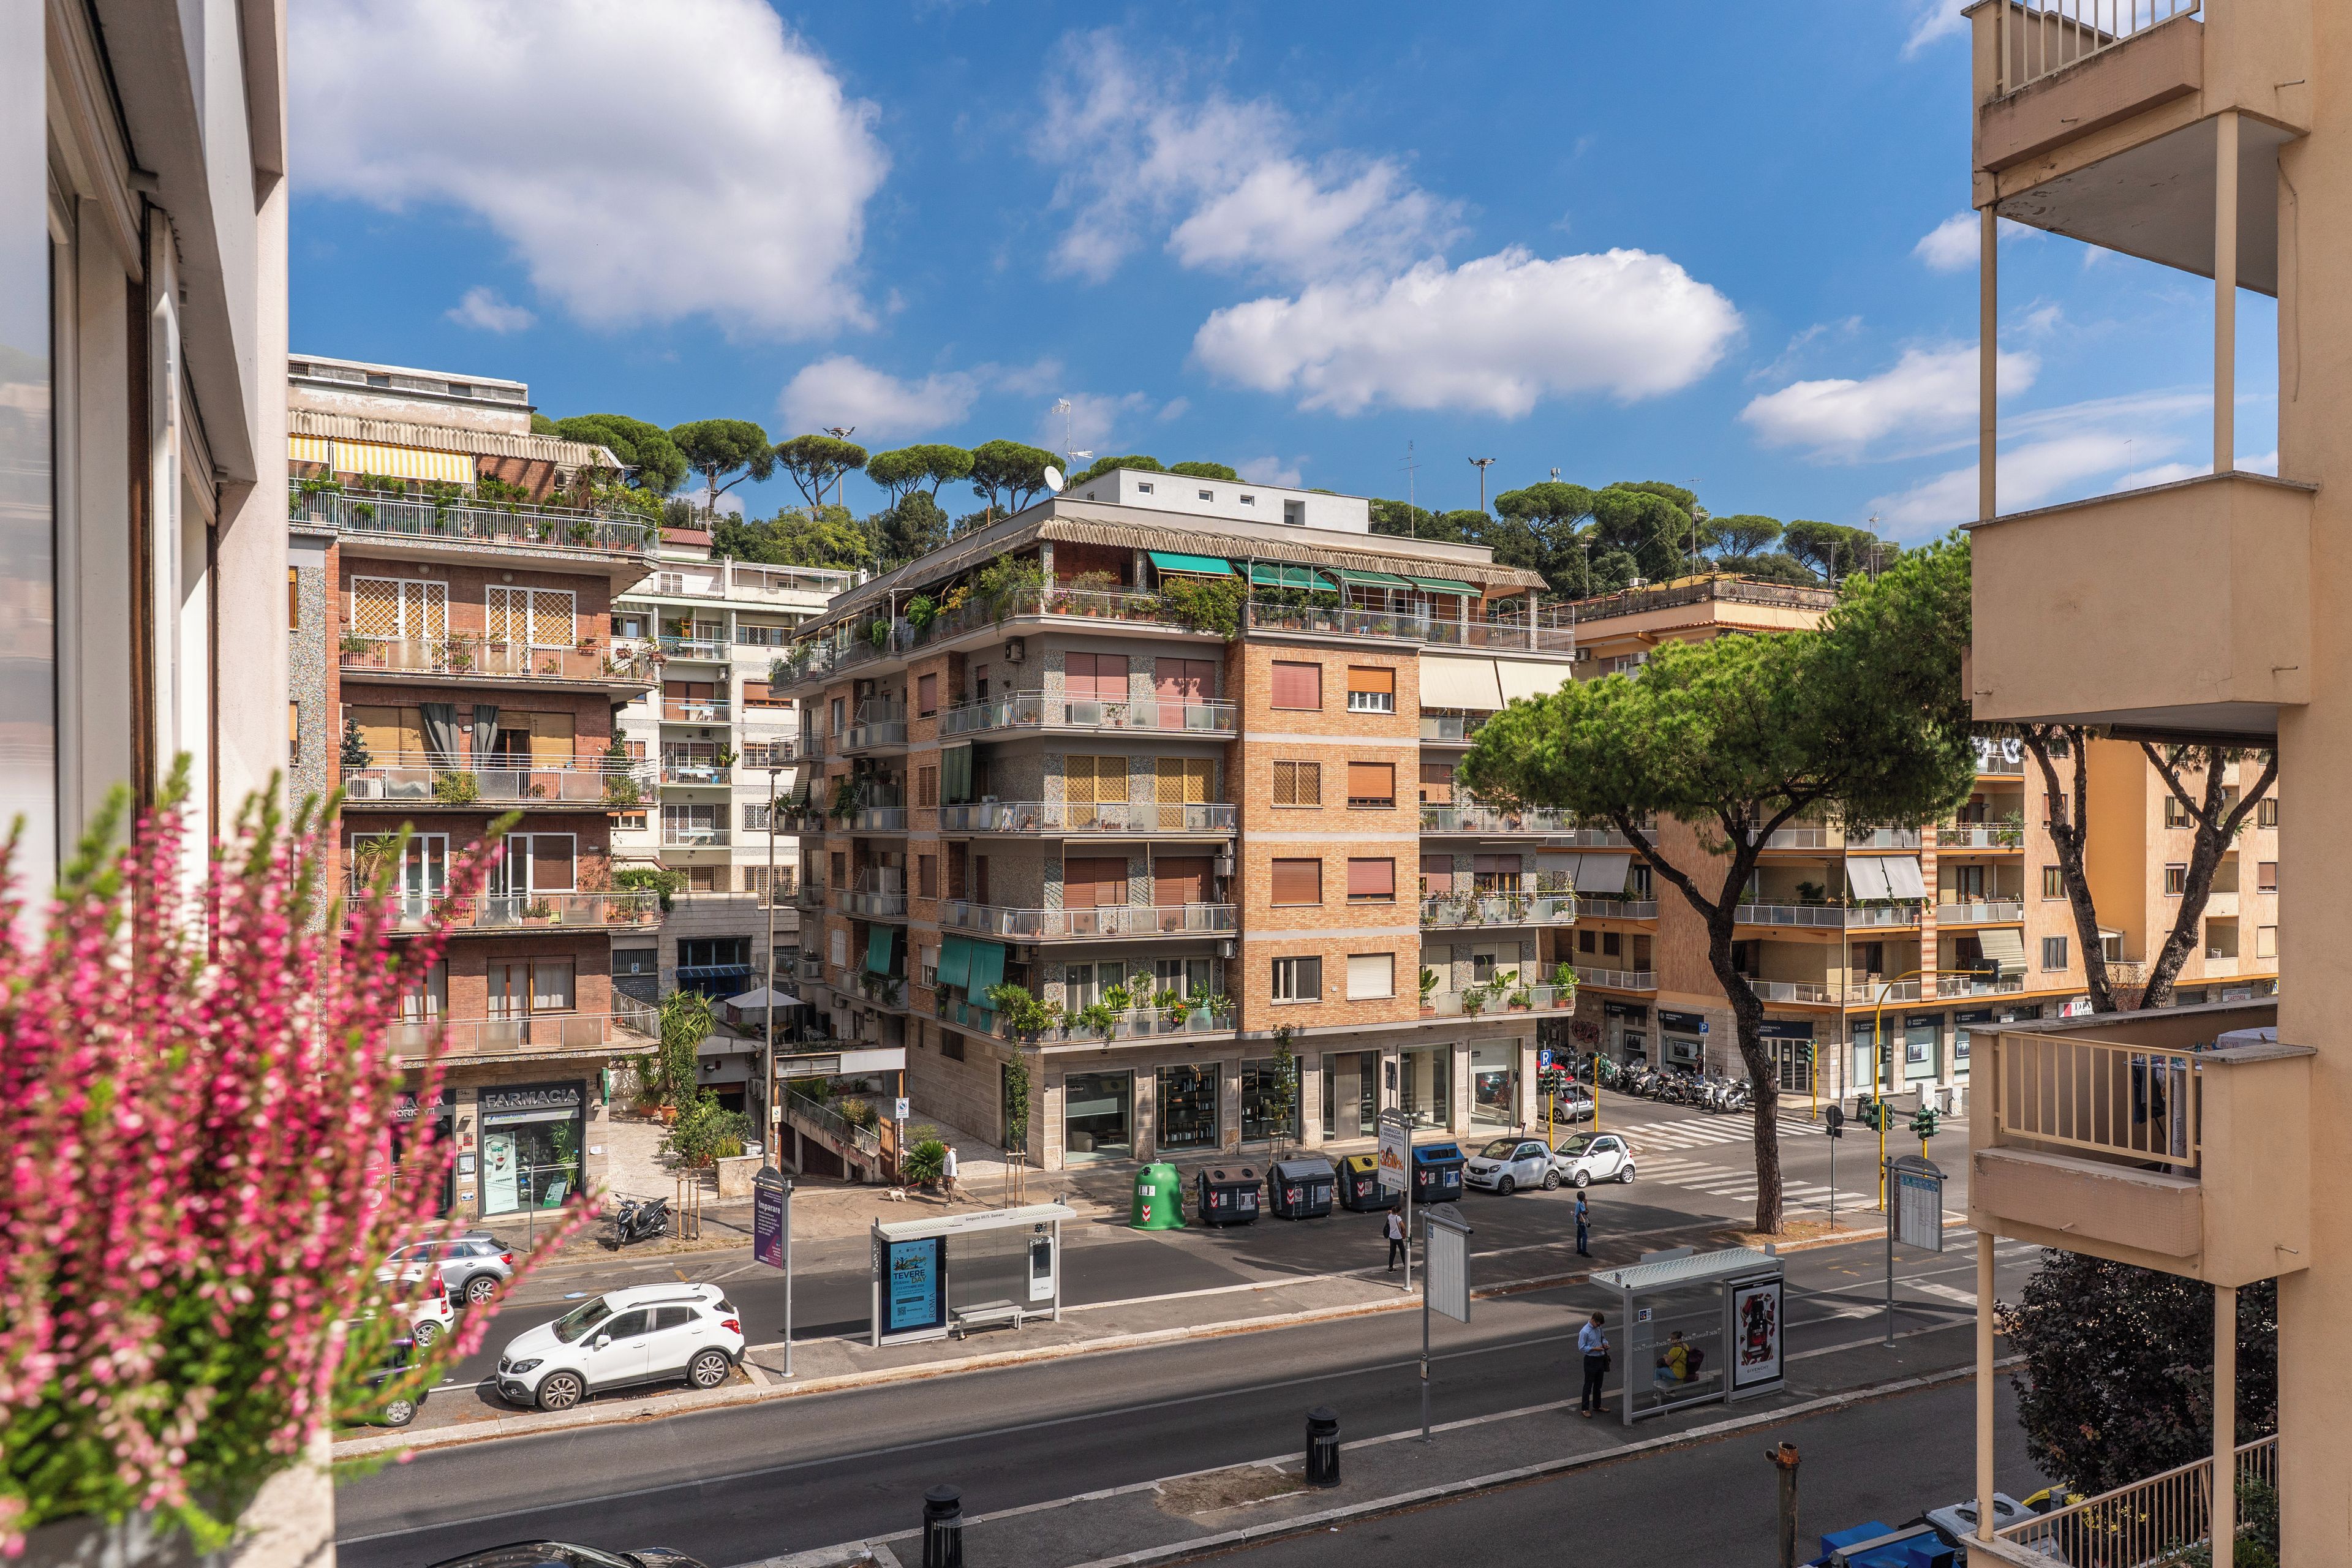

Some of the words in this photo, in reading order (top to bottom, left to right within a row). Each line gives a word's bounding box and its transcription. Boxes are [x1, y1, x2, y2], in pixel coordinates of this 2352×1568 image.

[485, 1088, 580, 1109] FARMACIA
[1383, 1131, 1403, 1141] RENDIMENTO
[758, 1200, 781, 1214] Imparare
[893, 1269, 925, 1280] TEVERE
[911, 1275, 927, 1284] DAY
[1747, 1365, 1769, 1373] GIVENCHY
